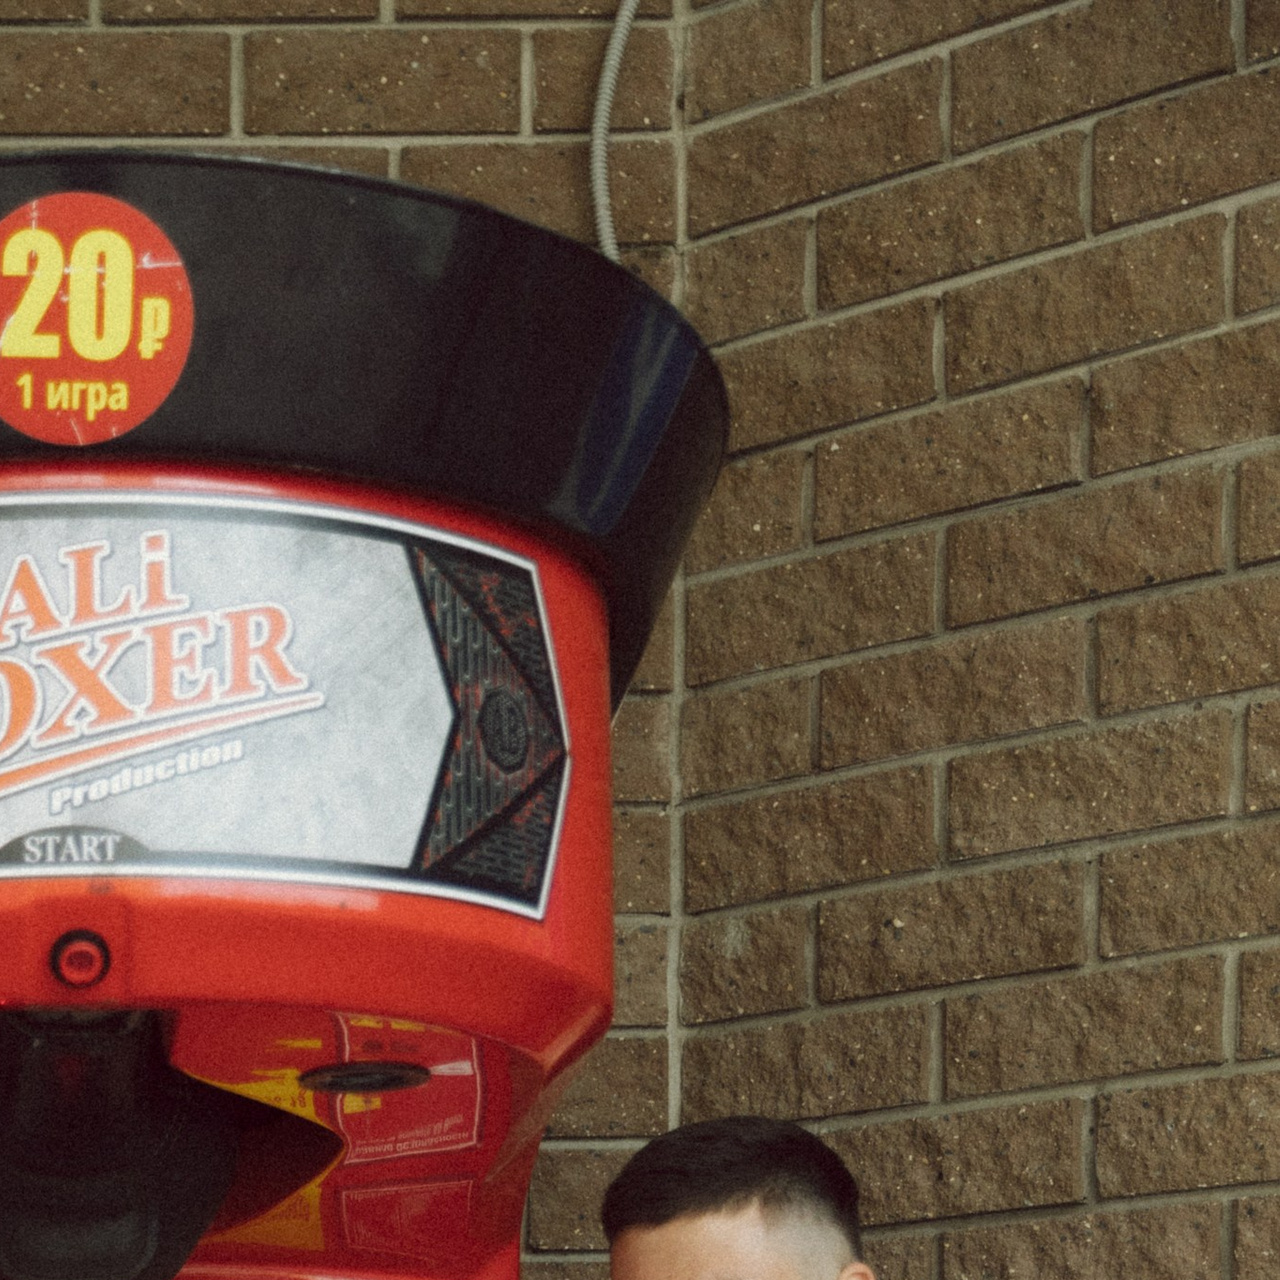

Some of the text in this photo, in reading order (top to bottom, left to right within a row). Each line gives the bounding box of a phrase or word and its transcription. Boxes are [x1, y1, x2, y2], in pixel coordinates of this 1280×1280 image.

[17, 372, 129, 422] 1 игра
[48, 738, 244, 816] Production
[23, 833, 120, 864] START
